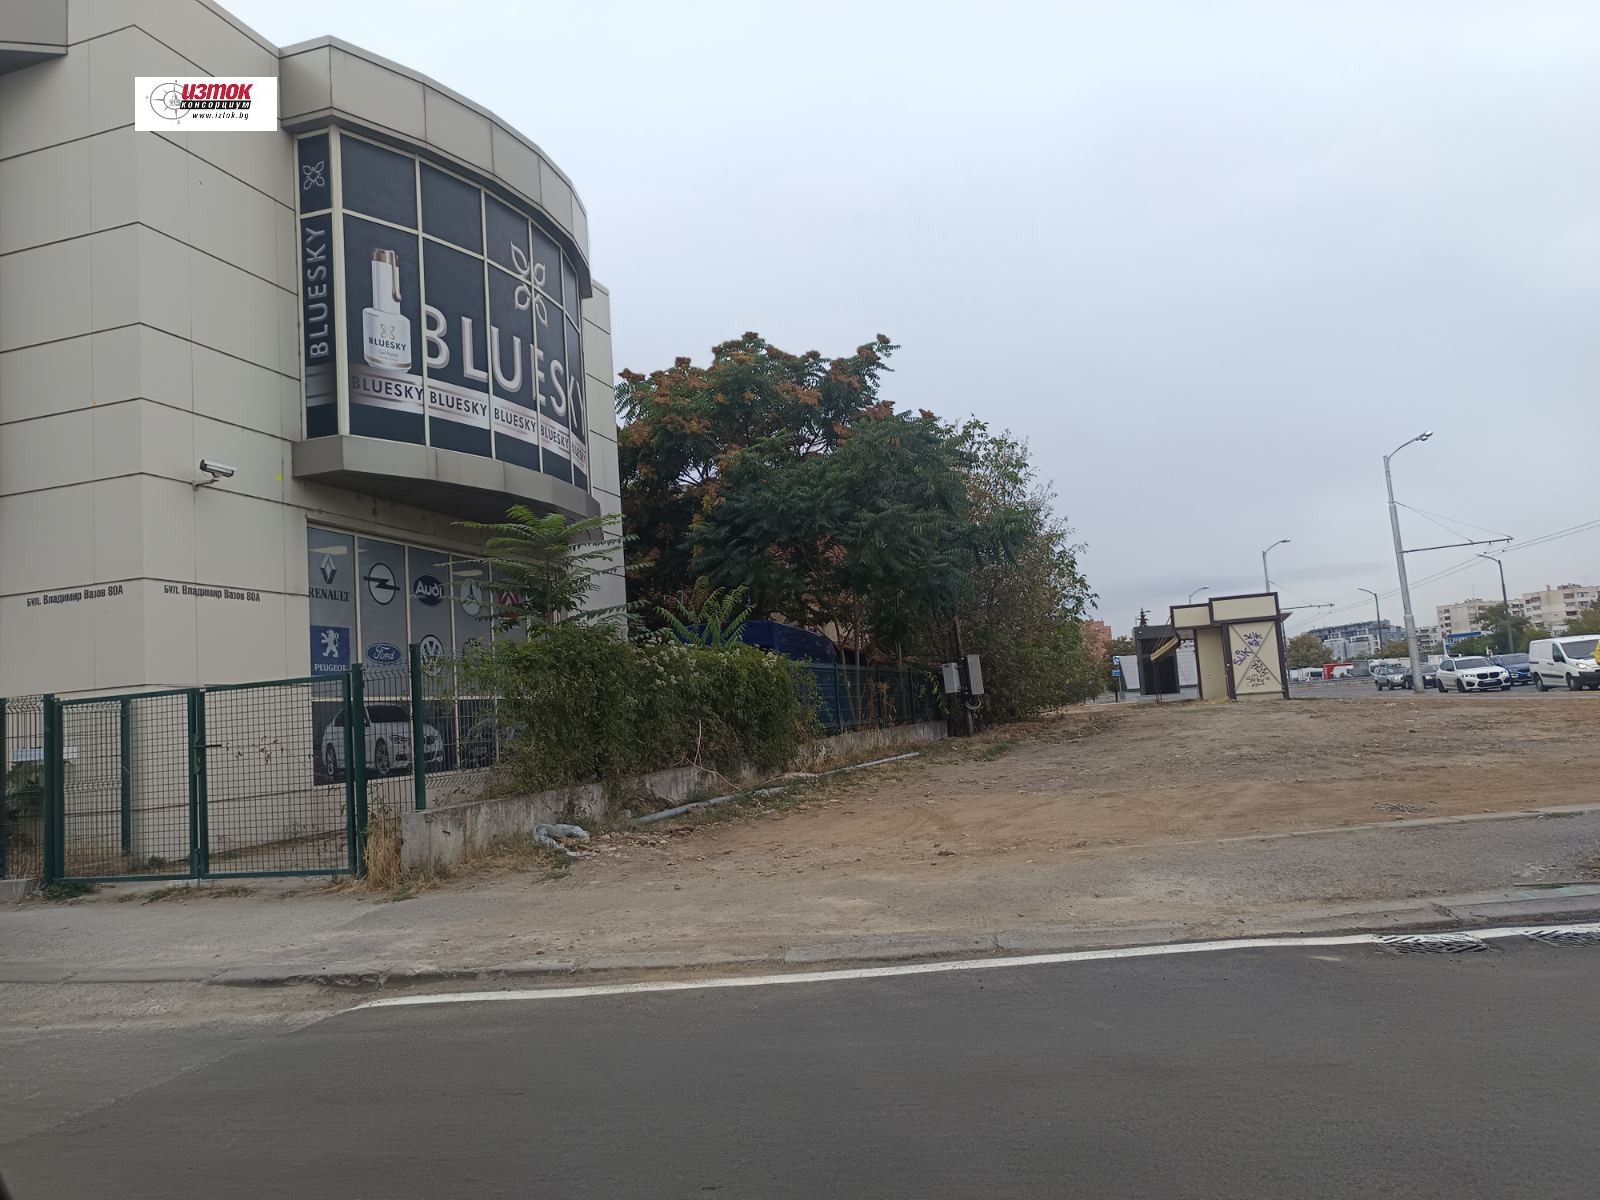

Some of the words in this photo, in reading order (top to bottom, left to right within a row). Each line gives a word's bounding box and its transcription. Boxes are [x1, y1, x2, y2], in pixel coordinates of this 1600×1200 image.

[305, 226, 329, 359] BLUESKY
[368, 336, 407, 351] BLUESKY
[352, 376, 423, 400] BLUESKY
[430, 391, 487, 416] BLUESKY
[494, 407, 536, 432] BLUESKY
[540, 425, 569, 449] BLUESKY
[84, 589, 105, 599] Вазов
[182, 585, 222, 599] Владимир
[224, 589, 244, 600] Вазов
[309, 587, 349, 602] RENAULT
[416, 581, 443, 597] Audi
[374, 646, 395, 660] Ford
